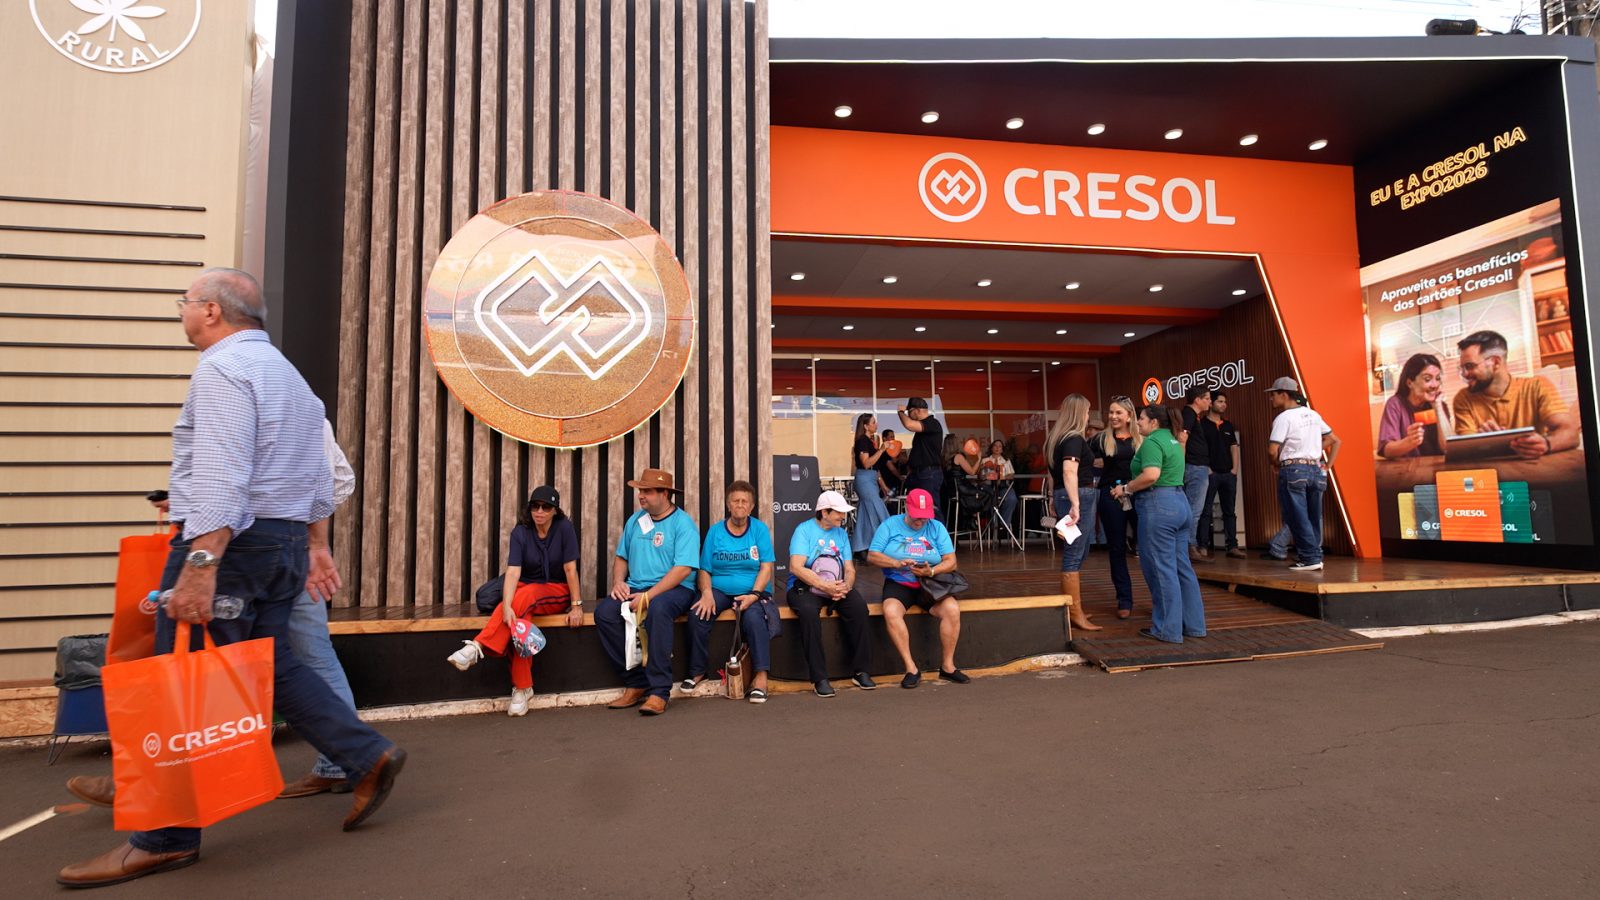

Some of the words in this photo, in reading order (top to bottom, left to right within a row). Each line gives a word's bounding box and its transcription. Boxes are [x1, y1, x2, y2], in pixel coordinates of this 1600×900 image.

[57, 30, 170, 67] RURAL
[1370, 185, 1391, 206] EU
[1394, 179, 1404, 196] E
[1407, 173, 1420, 191] A
[1422, 142, 1490, 183] CRESOL
[1493, 126, 1527, 153] NA
[1400, 161, 1489, 210] EXPO2026
[1003, 167, 1236, 226] CRESOL
[1380, 278, 1437, 302] Aproveite
[1438, 271, 1454, 285] os
[1455, 249, 1529, 280] benefícios
[1393, 299, 1415, 313] dos
[1416, 284, 1462, 306] cartões
[1464, 268, 1513, 292] Cresol!
[782, 502, 812, 512] CRESOL
[1454, 508, 1488, 518] CRESOL
[167, 713, 268, 752] CRESOL
